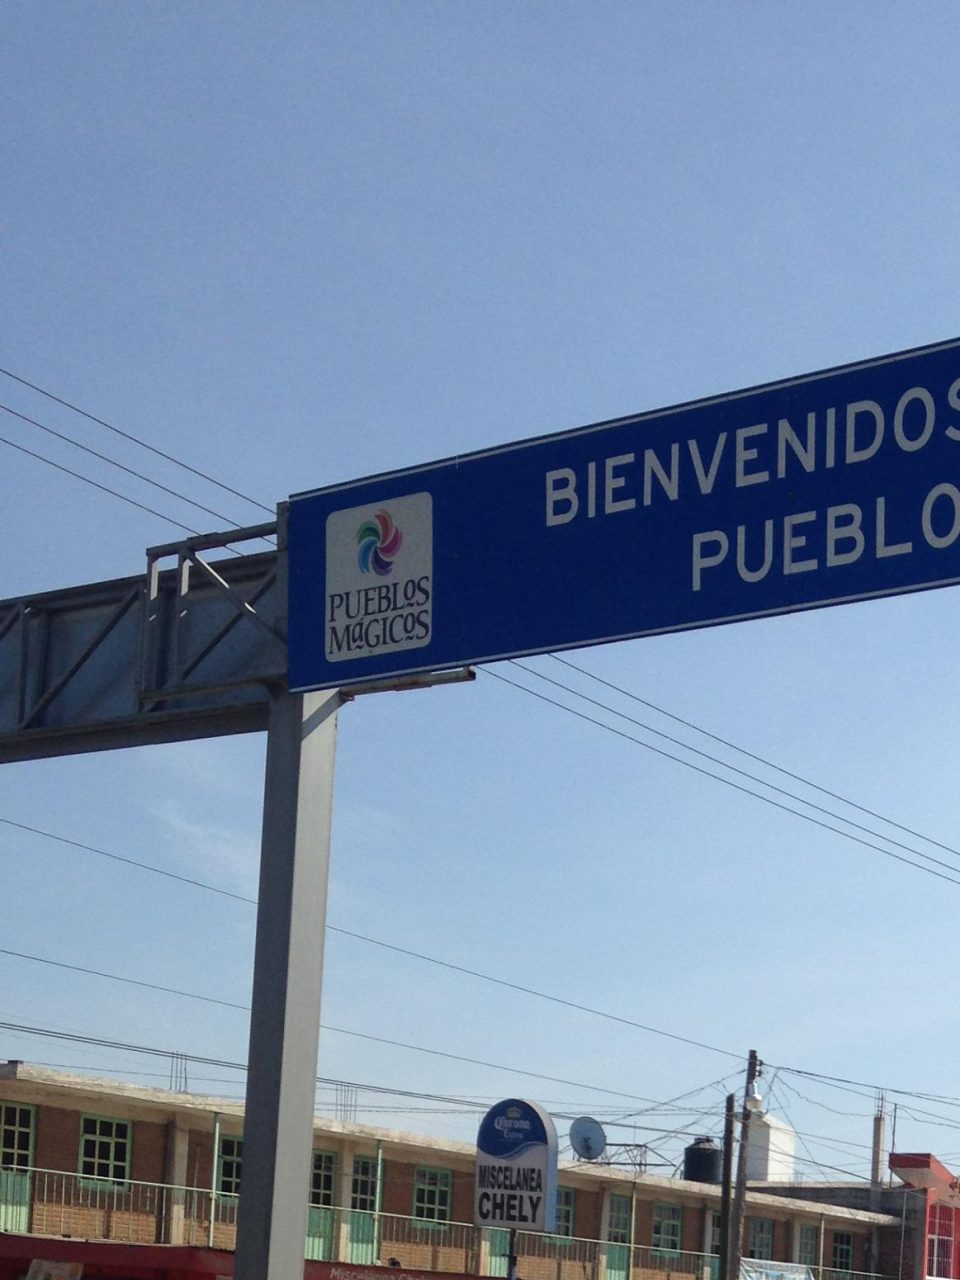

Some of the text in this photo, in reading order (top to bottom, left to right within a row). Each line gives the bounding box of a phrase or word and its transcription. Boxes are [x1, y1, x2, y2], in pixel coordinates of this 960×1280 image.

[328, 576, 430, 623] PUEBLOS
[494, 1115, 531, 1130] Corona
[478, 1165, 543, 1192] MISCELANEA
[478, 1191, 542, 1223] CHELY
